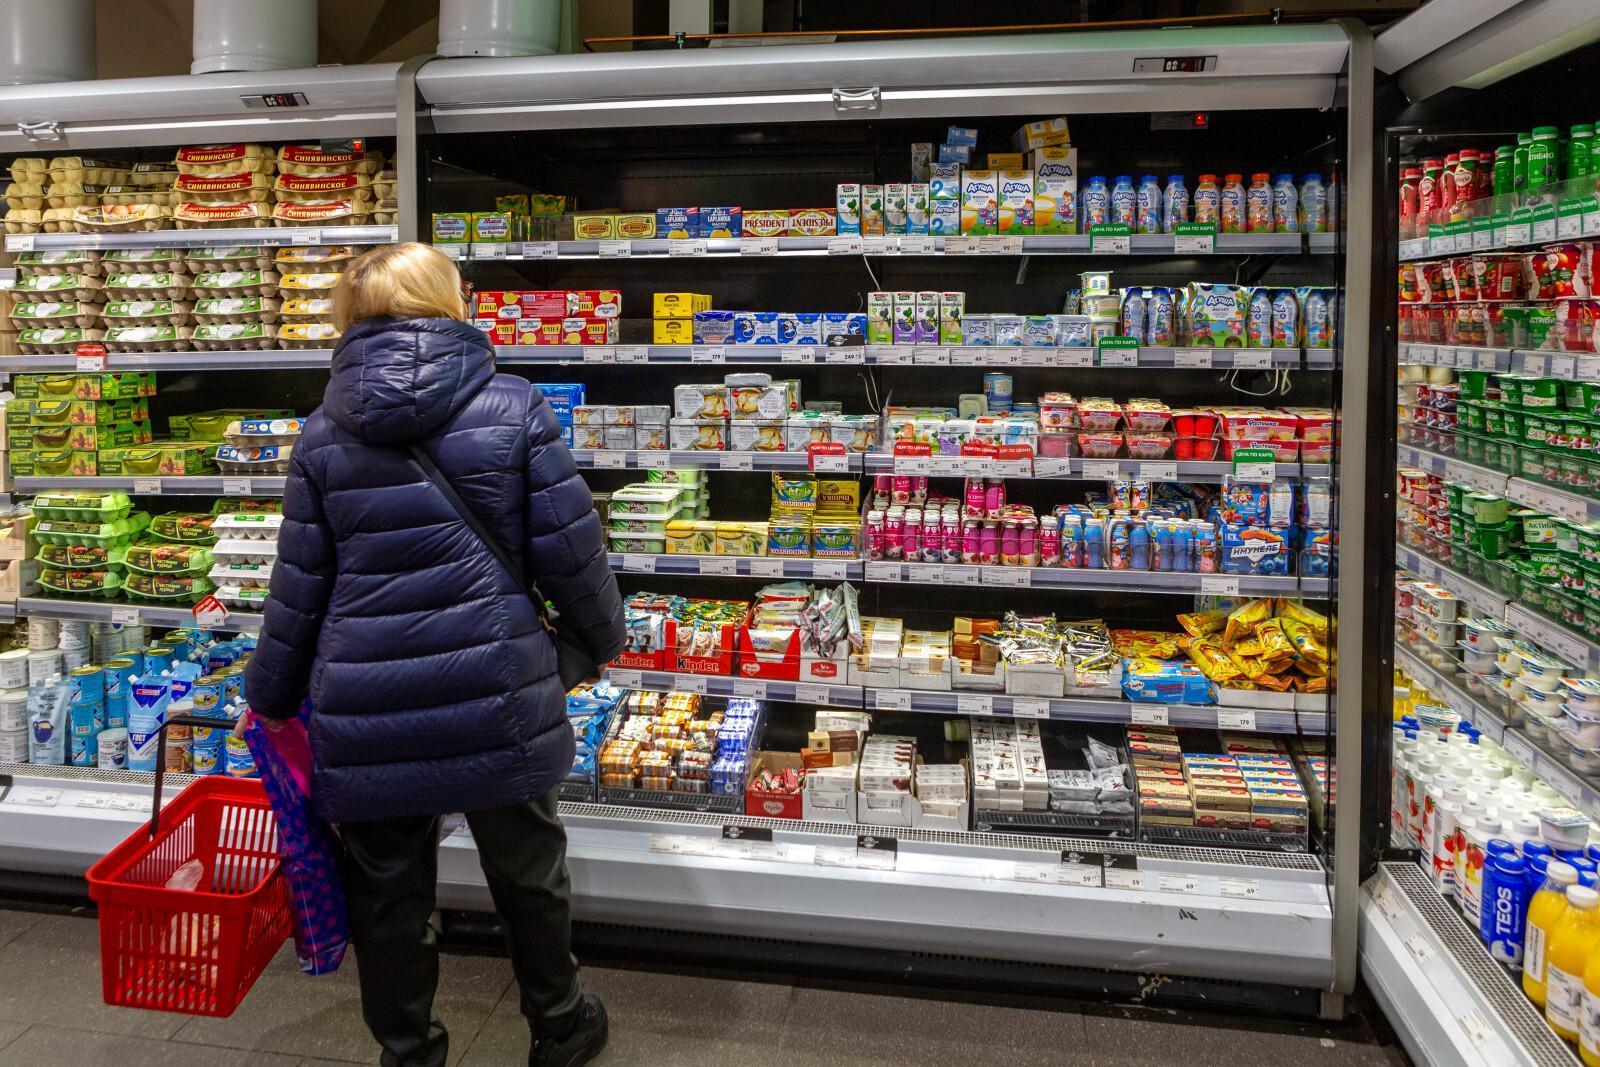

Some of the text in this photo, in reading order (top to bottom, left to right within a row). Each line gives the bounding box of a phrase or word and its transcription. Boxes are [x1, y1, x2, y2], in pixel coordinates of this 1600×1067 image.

[187, 153, 235, 162] СИНЯВИНСКОЕ
[294, 154, 352, 162] СИНЯВИНСКОЕ
[1038, 163, 1073, 177] АГУША
[187, 182, 241, 190] СИНЯВИНСКОЕ
[289, 182, 346, 190] СИНЯВИНСКОЕ
[931, 180, 944, 193] 2
[966, 182, 994, 194] АГУША
[1002, 182, 1031, 194] АГУША
[744, 218, 786, 229] PRÉSIDENT
[1206, 295, 1235, 307] АГУША
[1232, 544, 1278, 555] ИМУНЕЛЕ
[612, 654, 655, 668] Kinder
[676, 656, 719, 672] Kinder
[132, 734, 146, 743] ГОСТ
[1496, 887, 1512, 935] TEOS
